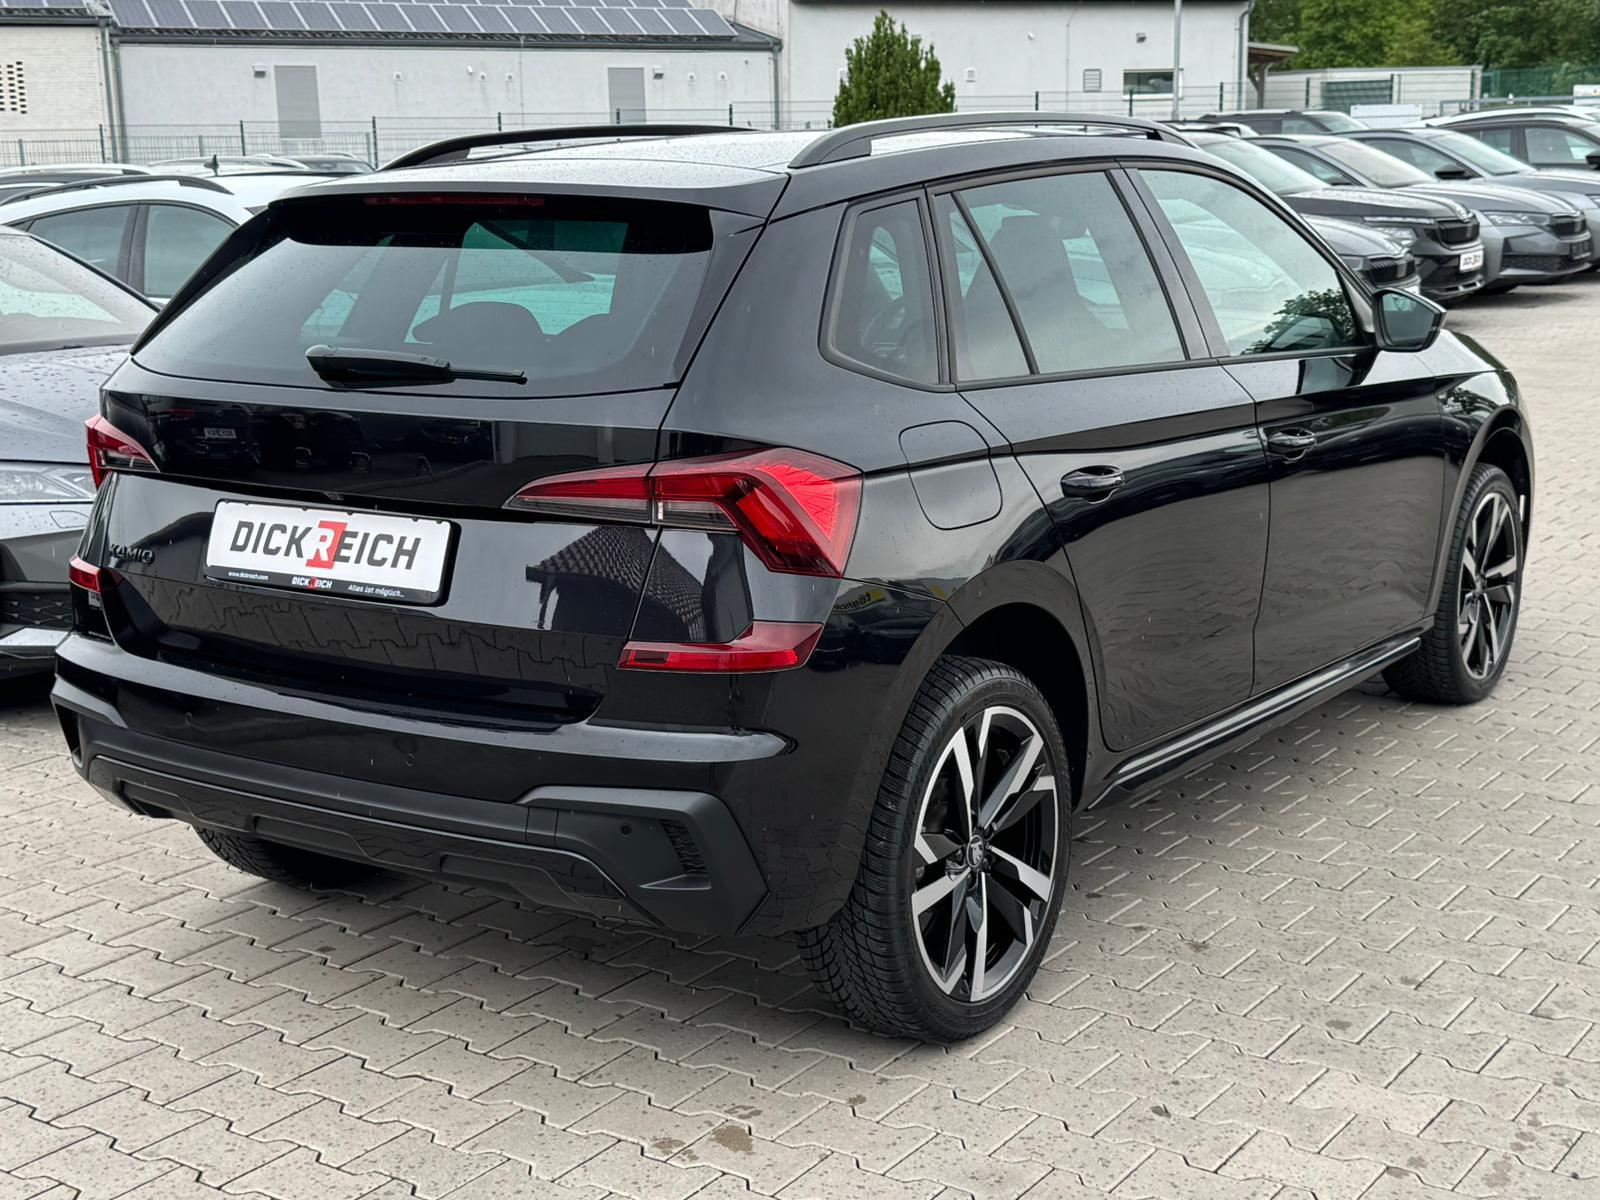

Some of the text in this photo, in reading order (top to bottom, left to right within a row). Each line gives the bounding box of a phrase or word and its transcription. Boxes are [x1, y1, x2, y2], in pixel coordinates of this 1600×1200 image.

[230, 520, 421, 570] DICKREICH
[292, 575, 333, 591] DICKREICH
[348, 584, 364, 593] Alles
[365, 586, 375, 594] ist
